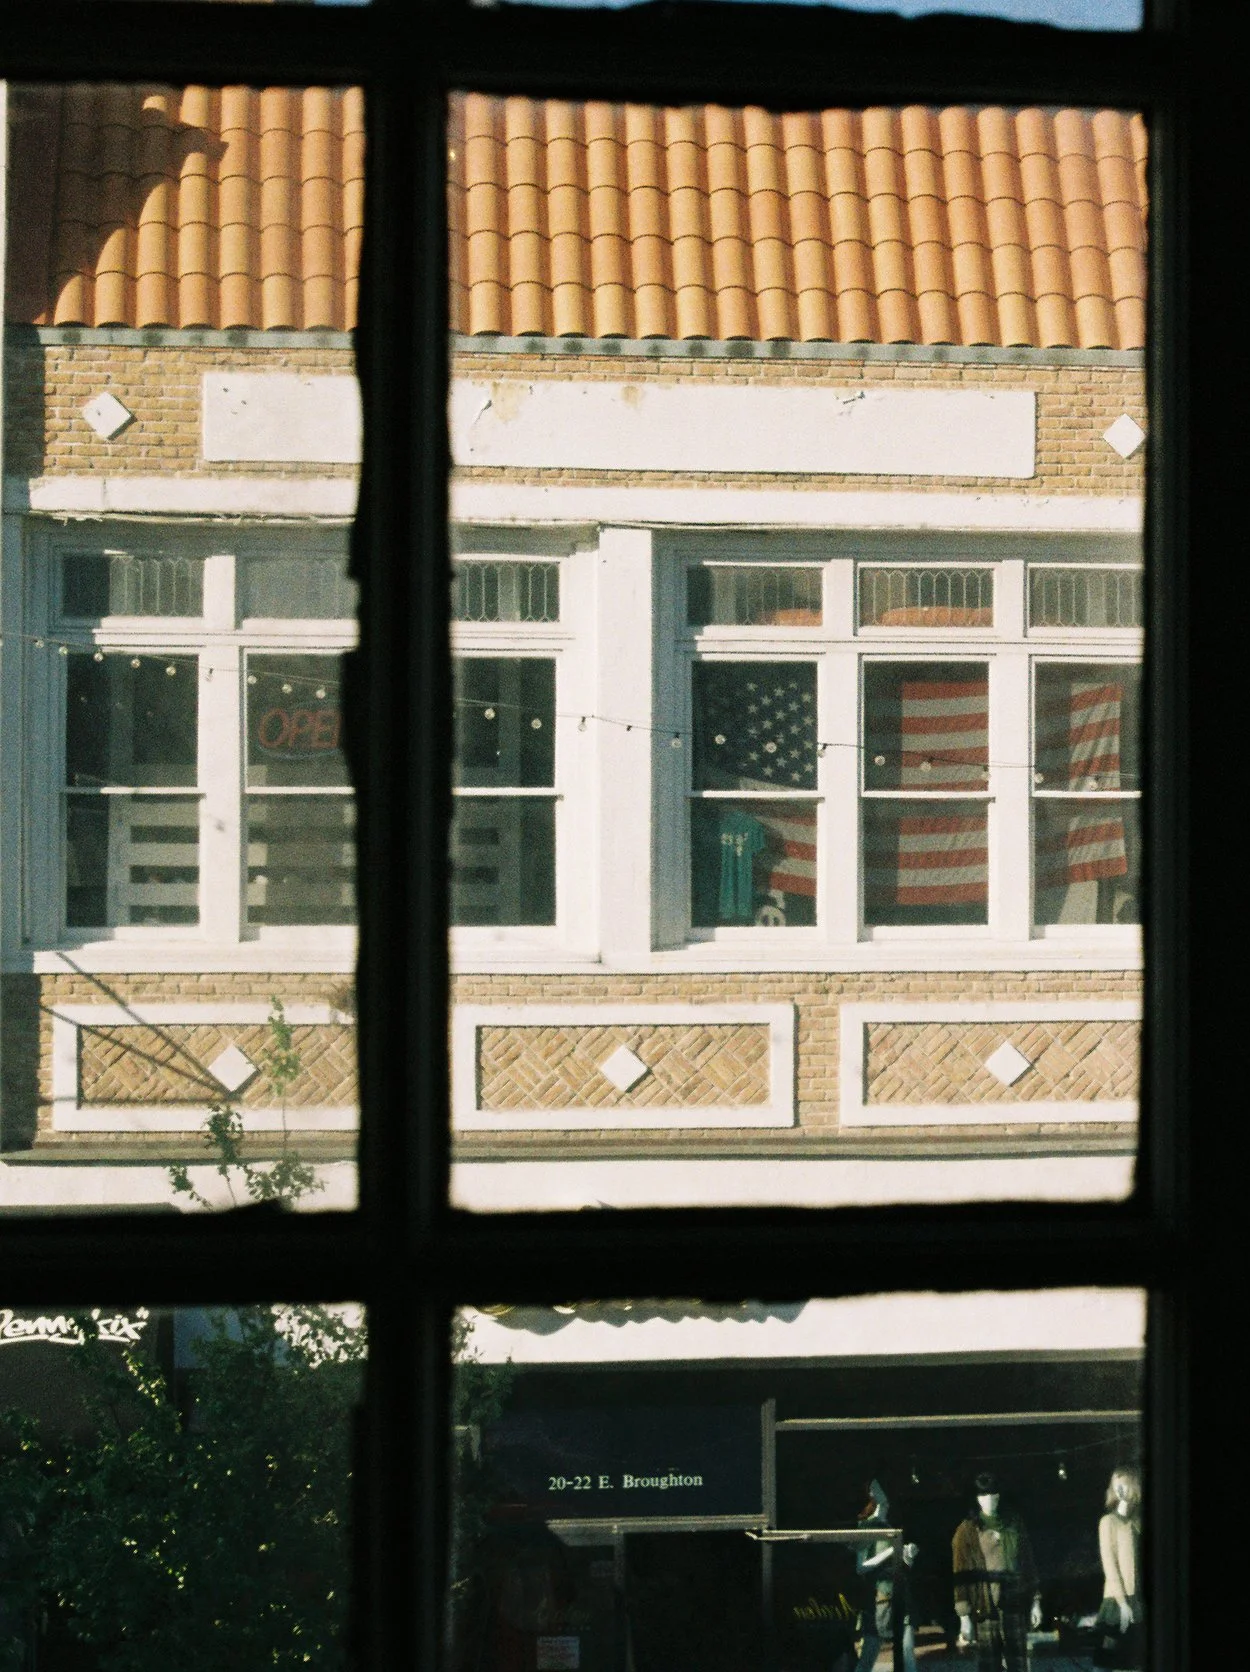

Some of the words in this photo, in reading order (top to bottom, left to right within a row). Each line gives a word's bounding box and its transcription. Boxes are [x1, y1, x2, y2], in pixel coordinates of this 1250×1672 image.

[258, 707, 342, 749] OPE
[547, 1475, 592, 1491] 20-22
[598, 1475, 614, 1490] E.
[621, 1473, 704, 1490] Broughton
